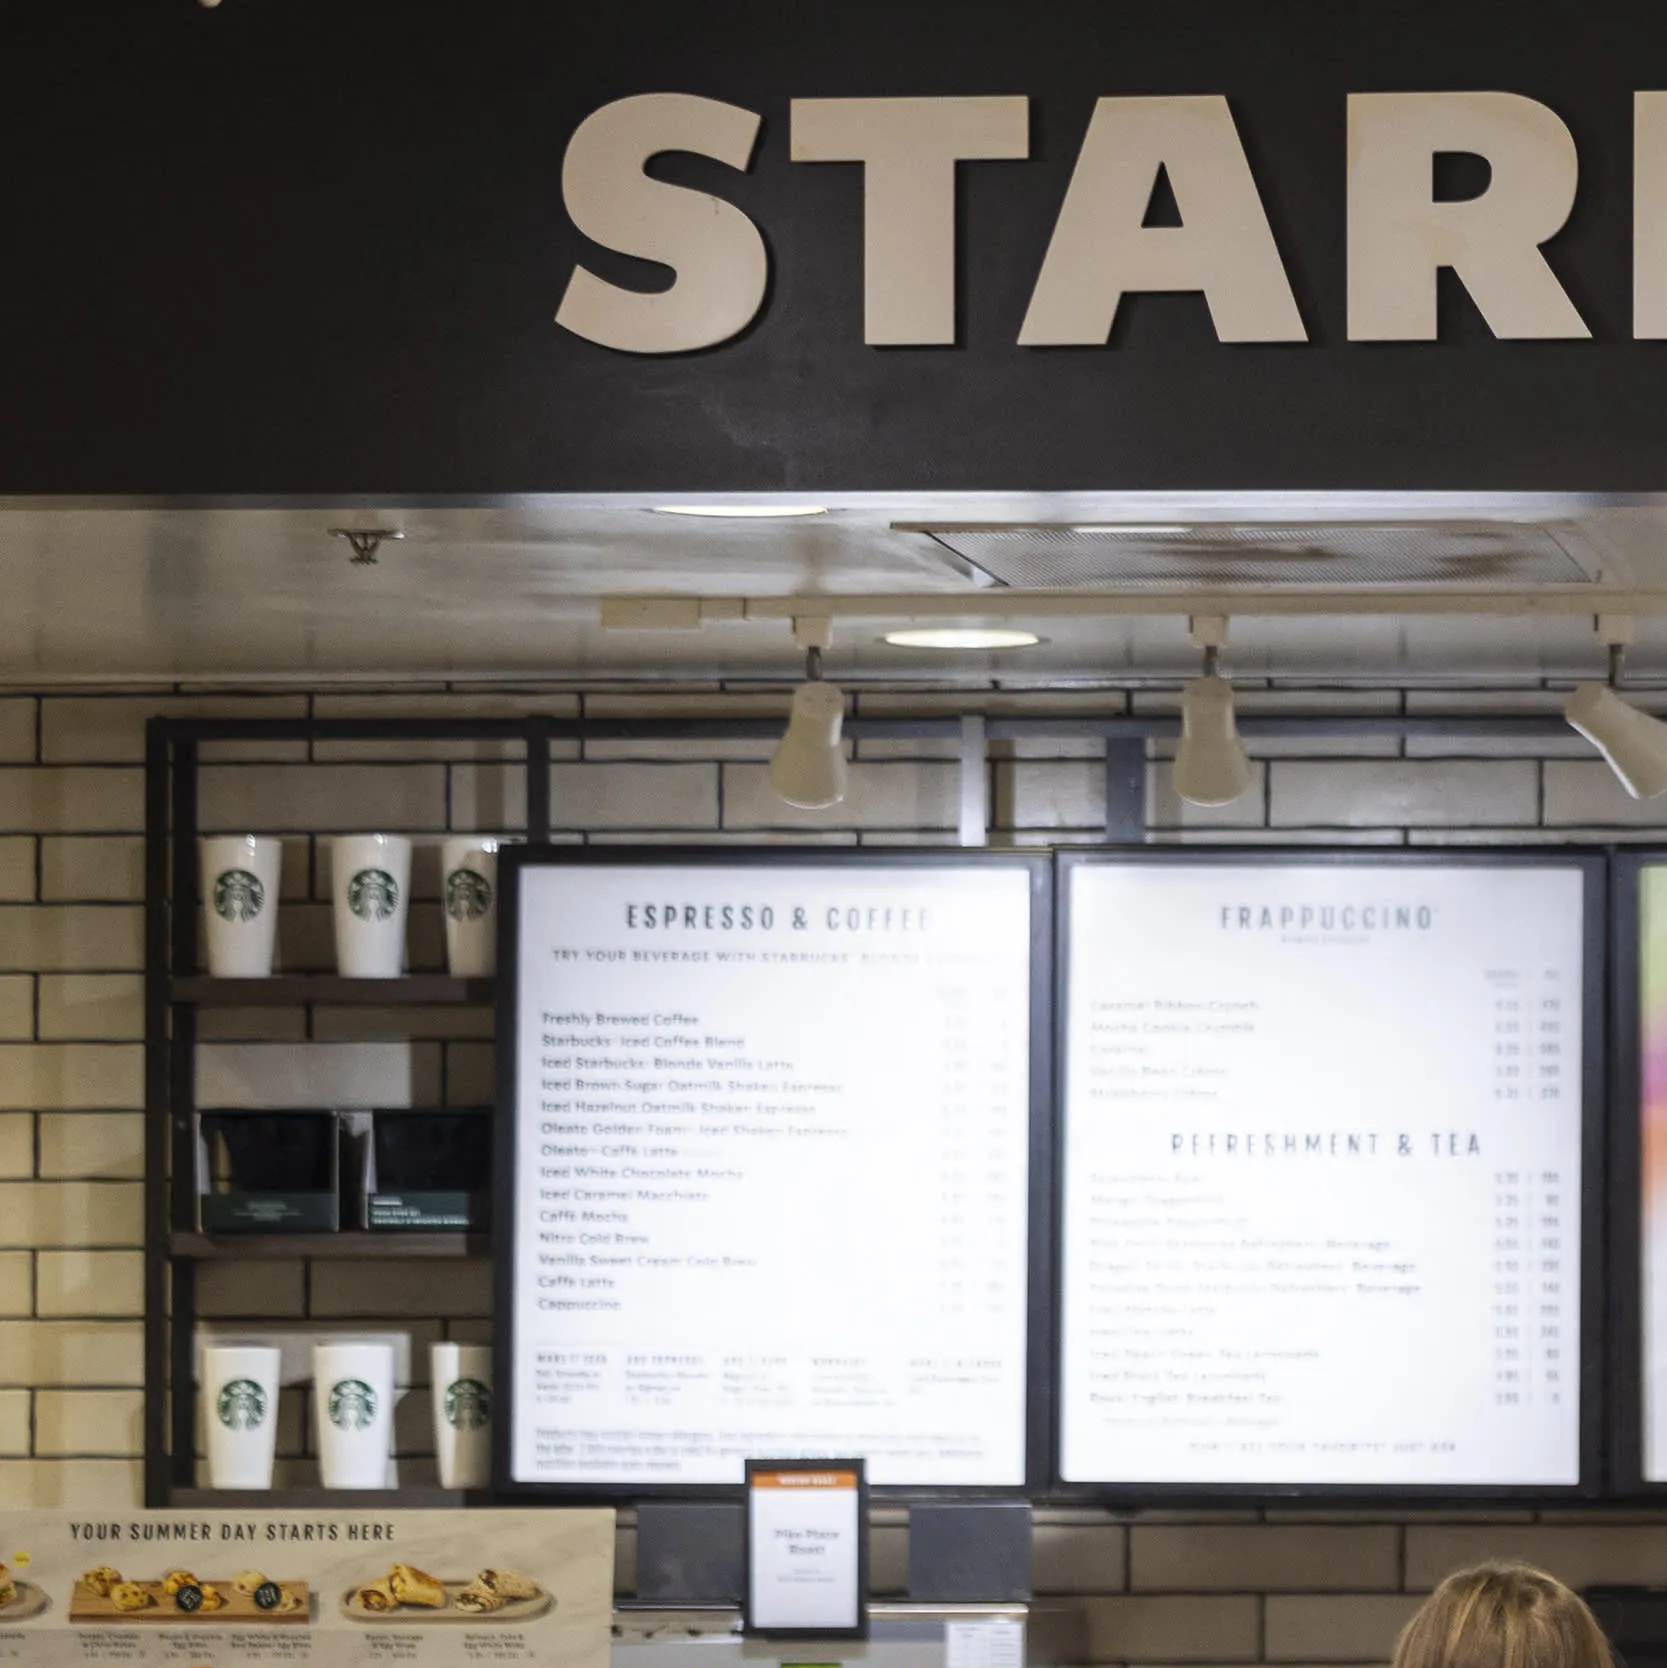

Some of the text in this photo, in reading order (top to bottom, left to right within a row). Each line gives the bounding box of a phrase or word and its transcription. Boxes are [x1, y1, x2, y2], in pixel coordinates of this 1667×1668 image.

[627, 905, 930, 931] ESPRESSO & COFFEE
[1221, 906, 1432, 930] FRAPPUCCINO
[1172, 1133, 1481, 1155] REFRESHMENT & TEA
[71, 1523, 395, 1540] YOUR SUMMER DAY STARTS HERE
